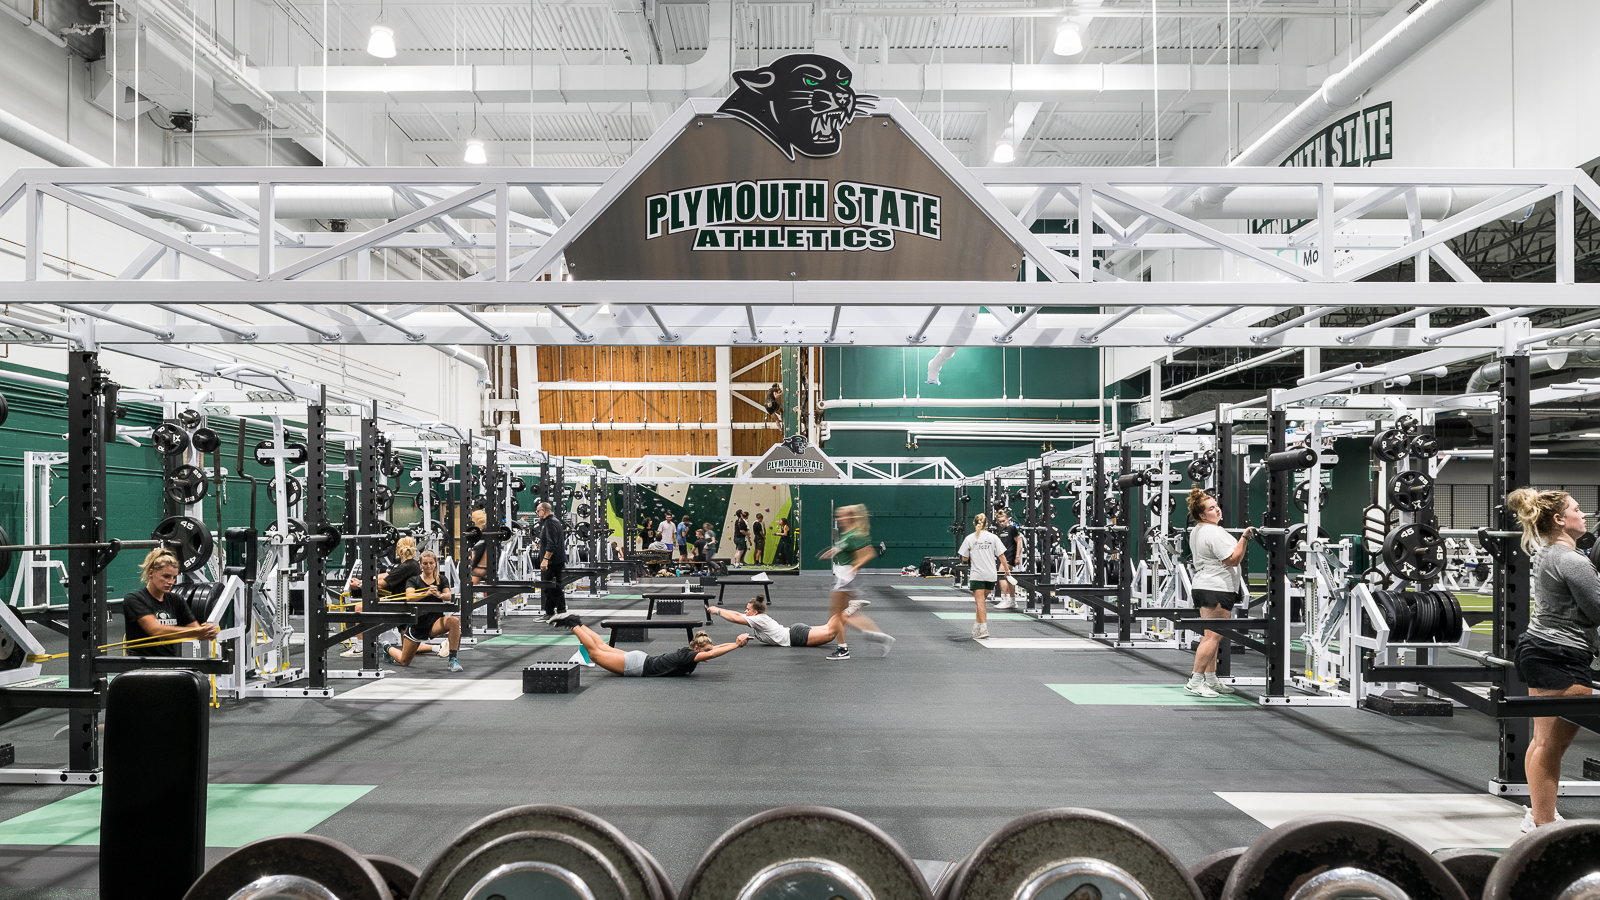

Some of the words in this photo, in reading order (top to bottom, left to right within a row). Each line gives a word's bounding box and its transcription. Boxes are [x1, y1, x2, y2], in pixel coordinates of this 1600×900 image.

[1331, 107, 1390, 167] STATE
[646, 180, 829, 240] PLYMOUTH
[833, 180, 941, 240] STATE
[693, 226, 895, 252] ATHLETICS
[767, 459, 802, 470] PLYMOUTH
[803, 459, 824, 470] STATE
[180, 520, 194, 530] 45
[1400, 527, 1415, 538] 45
[1436, 545, 1444, 560] 45
[183, 556, 196, 568] 45
